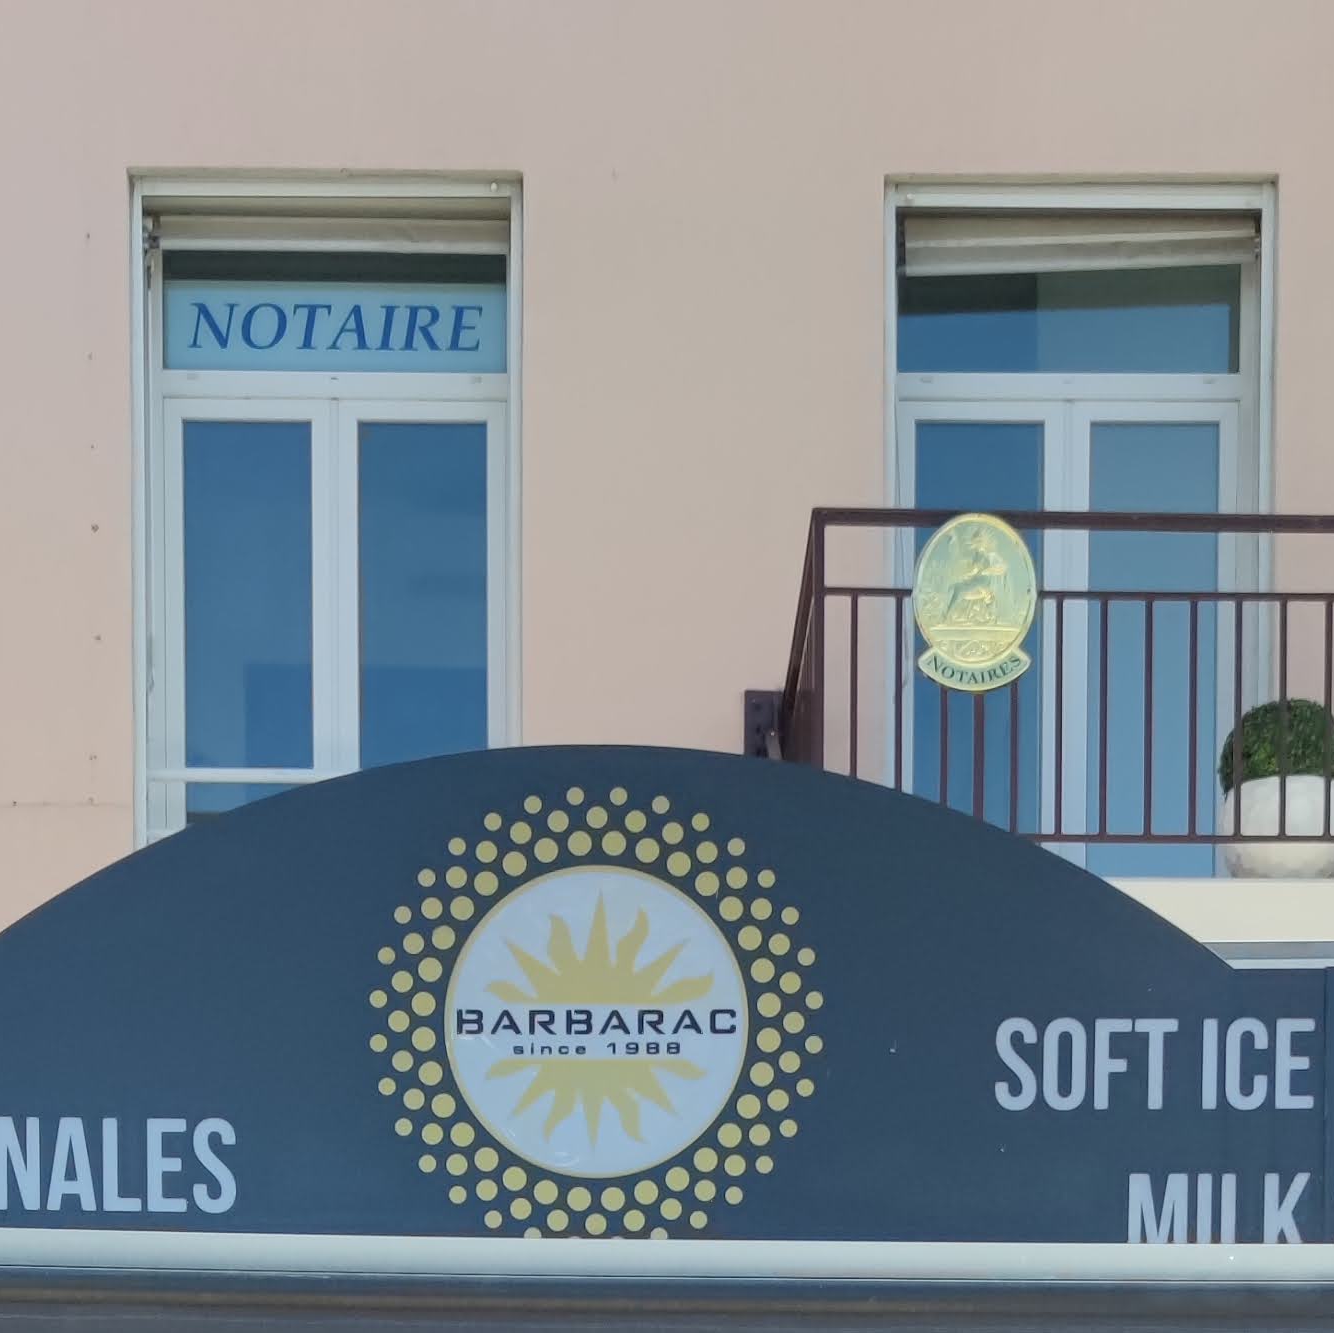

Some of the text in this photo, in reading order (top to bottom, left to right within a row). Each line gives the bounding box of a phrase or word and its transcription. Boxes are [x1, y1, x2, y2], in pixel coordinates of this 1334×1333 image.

[190, 302, 483, 352] NOTAIRE
[927, 655, 1022, 685] NOTAIRES
[455, 1008, 737, 1035] BARBARAC
[512, 1041, 681, 1055] since 1988
[994, 1017, 1179, 1111] SOFT
[1201, 1017, 1316, 1111] ICE
[1127, 1172, 1311, 1243] MILK
